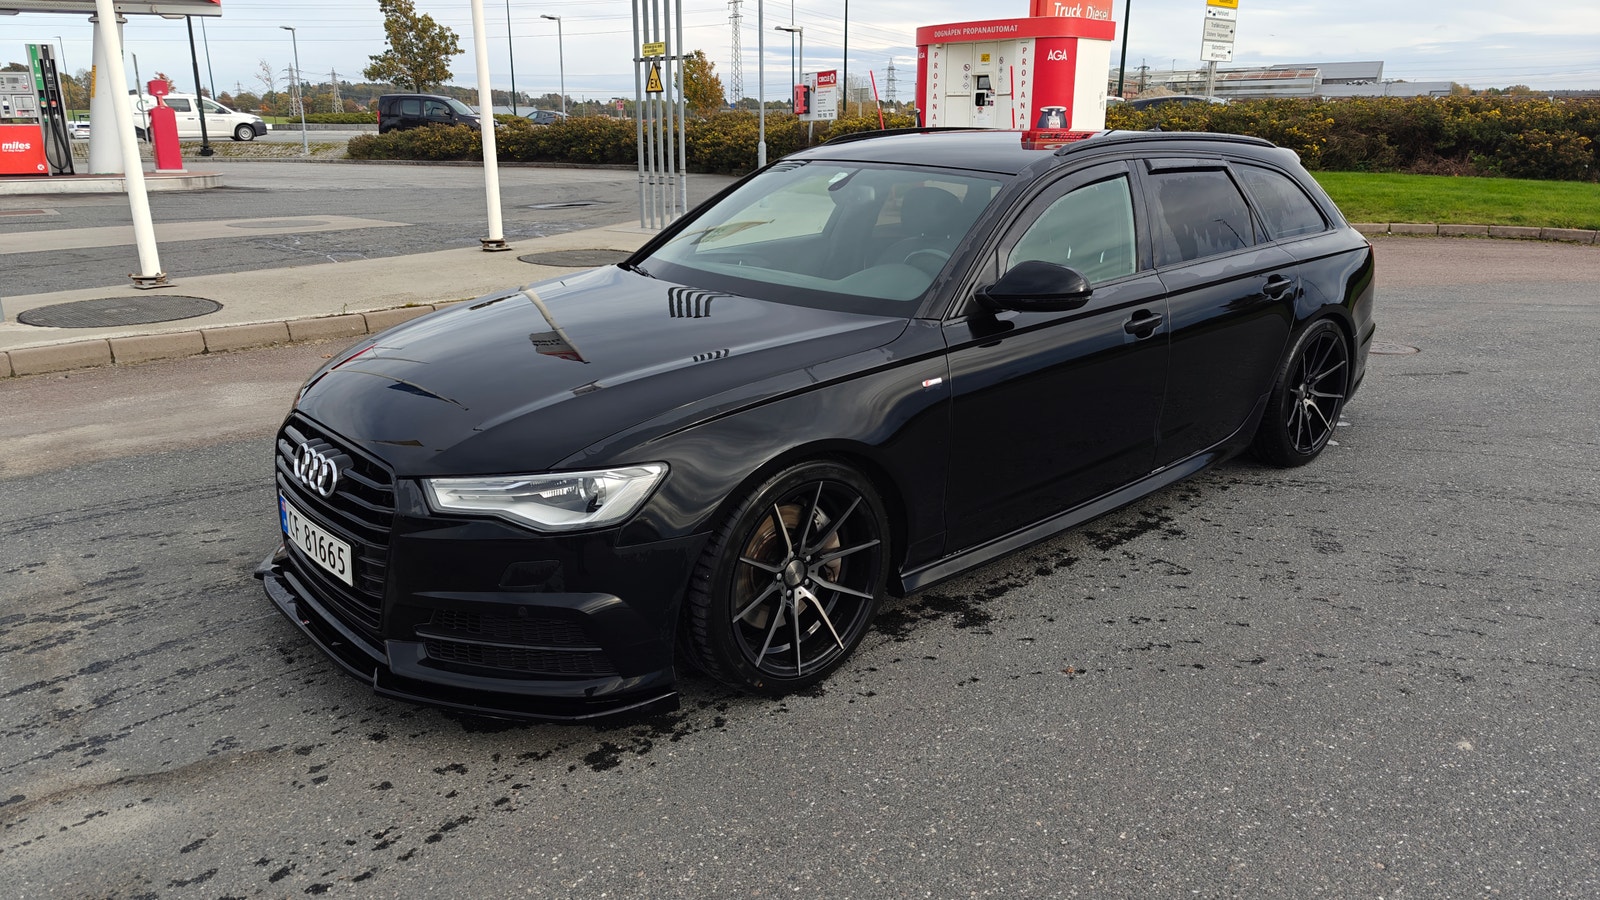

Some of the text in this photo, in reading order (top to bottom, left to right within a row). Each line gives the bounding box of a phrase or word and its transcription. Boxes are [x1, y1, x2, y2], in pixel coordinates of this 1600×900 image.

[1054, 2, 1109, 19] Truck Diesel
[963, 25, 1018, 35] PROPANAUTOMAT
[1047, 48, 1068, 61] AGA
[2, 141, 31, 149] miles
[289, 511, 345, 575] CF 81665
